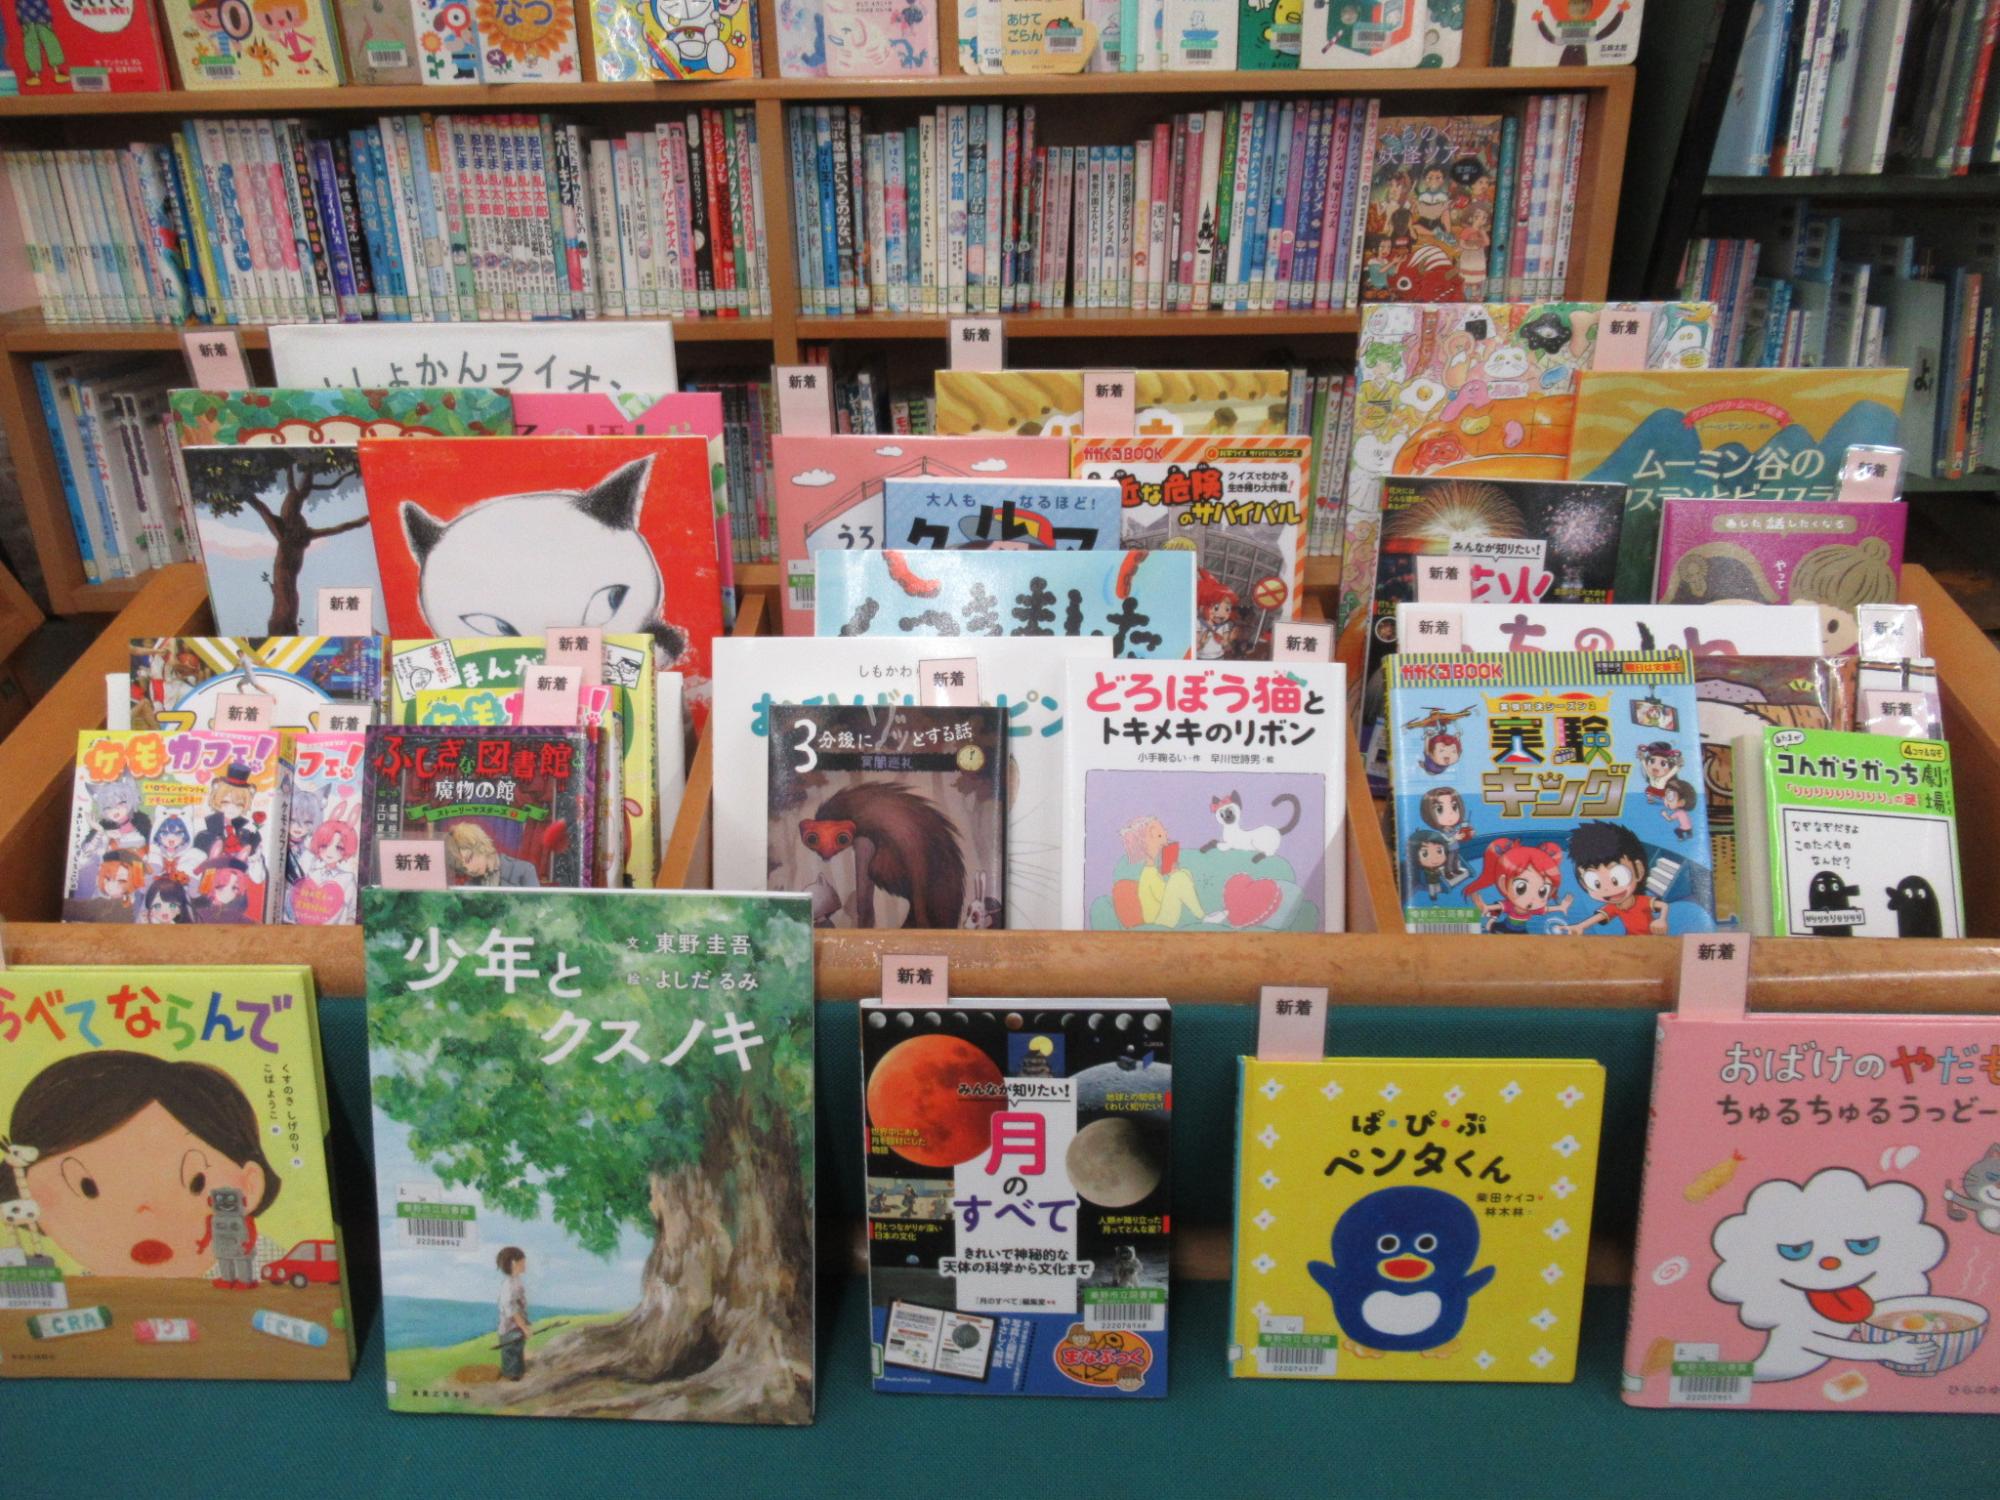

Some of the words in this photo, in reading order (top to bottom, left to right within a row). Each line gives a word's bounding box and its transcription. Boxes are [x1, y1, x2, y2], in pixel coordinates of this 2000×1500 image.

[1007, 13, 1041, 26] あけて
[1008, 28, 1043, 43] ごらん
[1381, 122, 1453, 141] みちのく
[1377, 145, 1477, 165] 妖怪ツアー
[962, 327, 991, 343] 新着
[1609, 319, 1639, 336] 新着
[199, 342, 228, 358] 新着
[322, 351, 622, 390] しょかんライオ
[788, 374, 817, 389] 新着
[1096, 383, 1124, 399] 新着
[1633, 446, 1826, 481] ムーミン谷の
[1228, 471, 1289, 481] クイズでわかる
[925, 493, 977, 508] 大人も
[1178, 500, 1302, 527] のサバイバル
[1452, 543, 1542, 557] みんなが知りたい！
[1429, 566, 1459, 581] 新着
[329, 595, 360, 611] 新着
[1419, 620, 1450, 636] 新着
[558, 636, 590, 651] 新着
[1286, 635, 1319, 652] 新着
[858, 664, 919, 679] しもかわ
[932, 670, 966, 687] 新着
[1400, 662, 1504, 681] かがくるBOOK
[537, 676, 569, 691] 新着
[1086, 670, 1326, 716] どろぼう猫と
[228, 705, 260, 722] 新着
[1880, 700, 1913, 717] 新着
[330, 716, 360, 731] 新着
[1102, 717, 1316, 747] トキメキのリボン
[1488, 715, 1614, 765] 実験
[434, 780, 517, 801] 魔物の館
[1482, 765, 1631, 818] キング
[1794, 839, 1852, 851] このたべもの
[395, 853, 431, 871] 新着
[1810, 855, 1852, 870] なんだ？
[1697, 942, 1736, 961] 新着
[403, 926, 583, 999] 少年と
[897, 967, 935, 985] 新着
[1275, 999, 1313, 1017] 新着
[540, 1010, 765, 1073] クスノキ
[957, 1083, 1070, 1098] みんなが知りたい！
[1351, 1109, 1487, 1138] ぱ・ぴ・ぷ
[984, 1111, 1046, 1176] 月
[1324, 1142, 1513, 1185] ペンタくん
[1003, 1176, 1029, 1197] の
[953, 1194, 1077, 1233] すべて
[964, 1246, 1069, 1261] きれいで神秘的な
[943, 1260, 1091, 1276] 天体の科学から文化まで
[1062, 1348, 1145, 1366] まなぶっく
